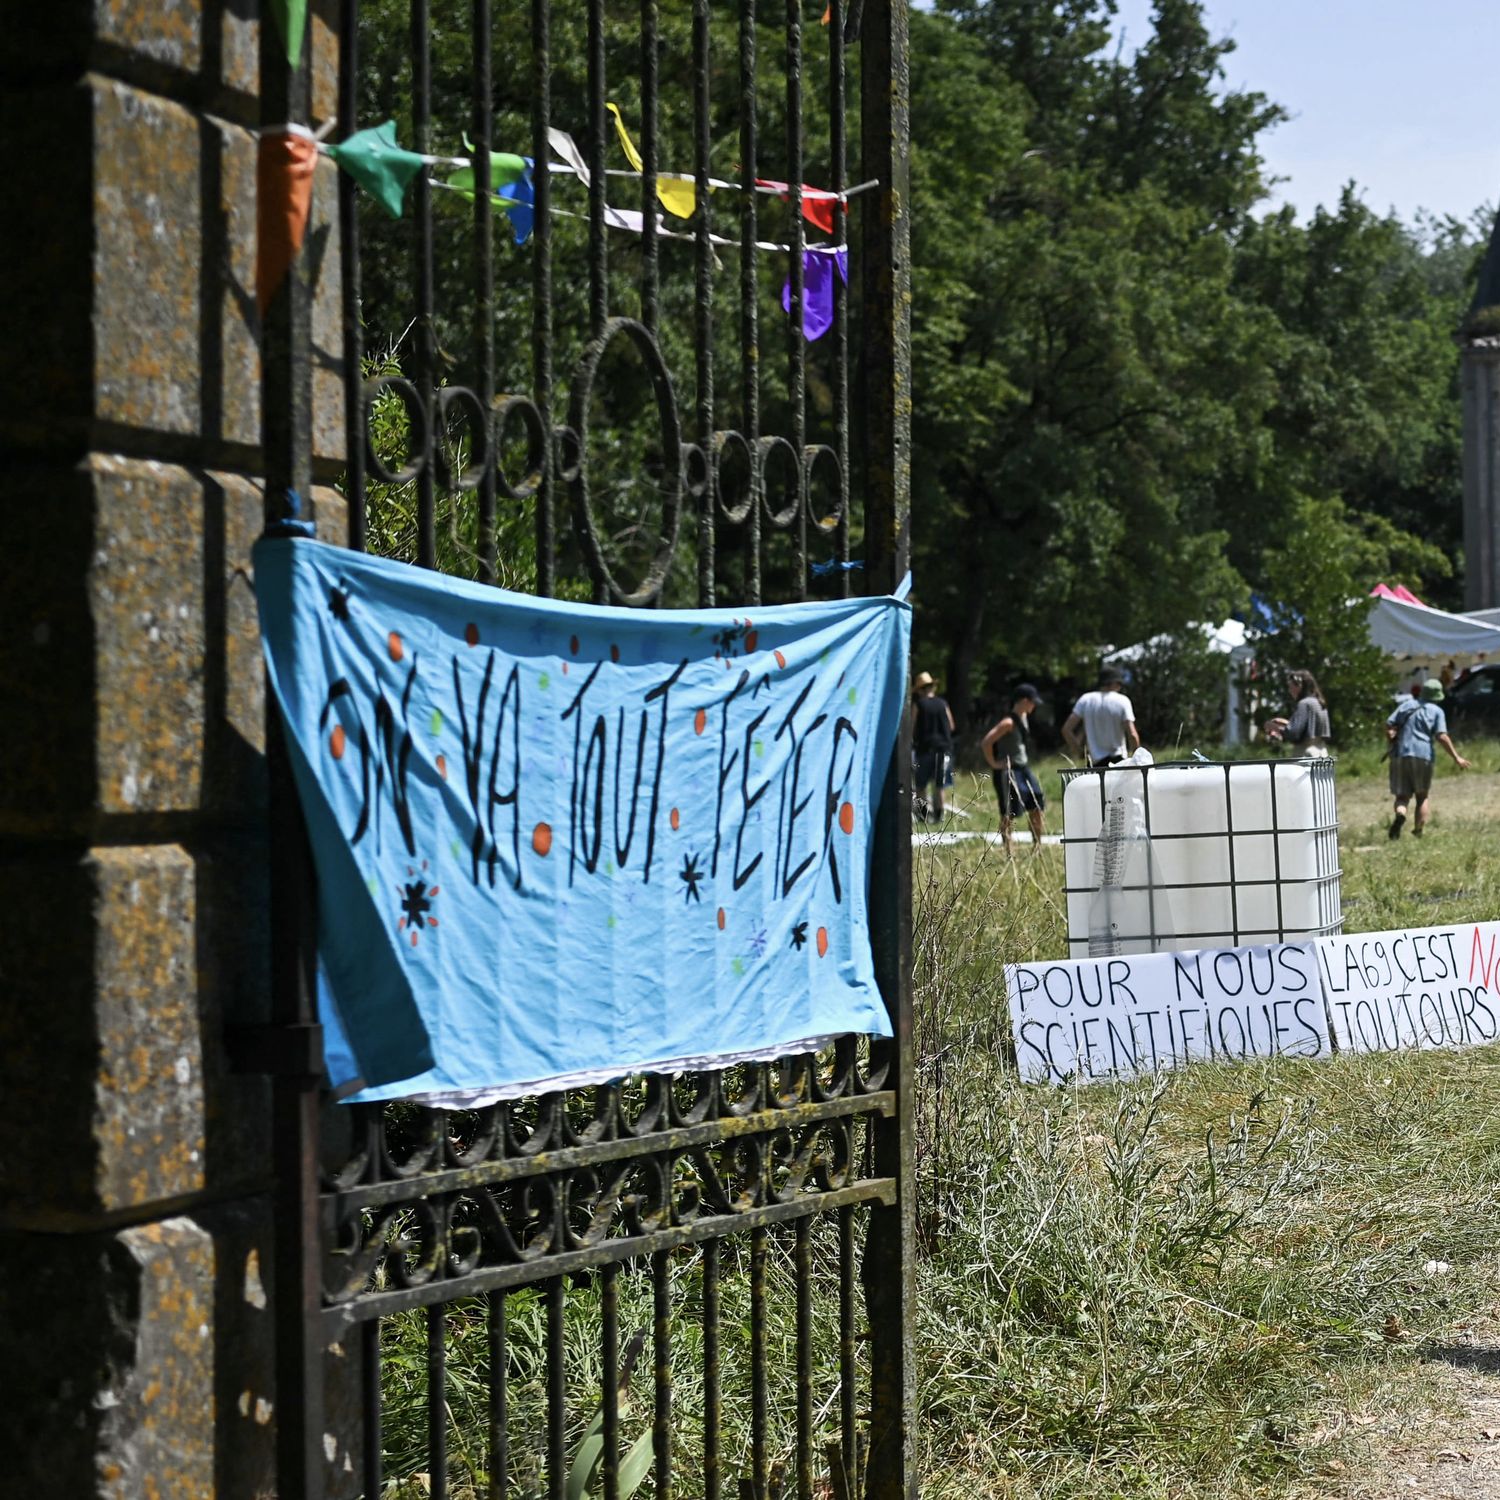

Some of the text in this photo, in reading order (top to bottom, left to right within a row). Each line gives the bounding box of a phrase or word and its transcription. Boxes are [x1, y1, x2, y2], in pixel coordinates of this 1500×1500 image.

[320, 648, 858, 905] ON VA TOUT FÊTER
[1016, 946, 1308, 1012] POUR NOUS
[1320, 933, 1459, 992] L'A69 C'EST
[1335, 985, 1497, 1053] TOUJOURS
